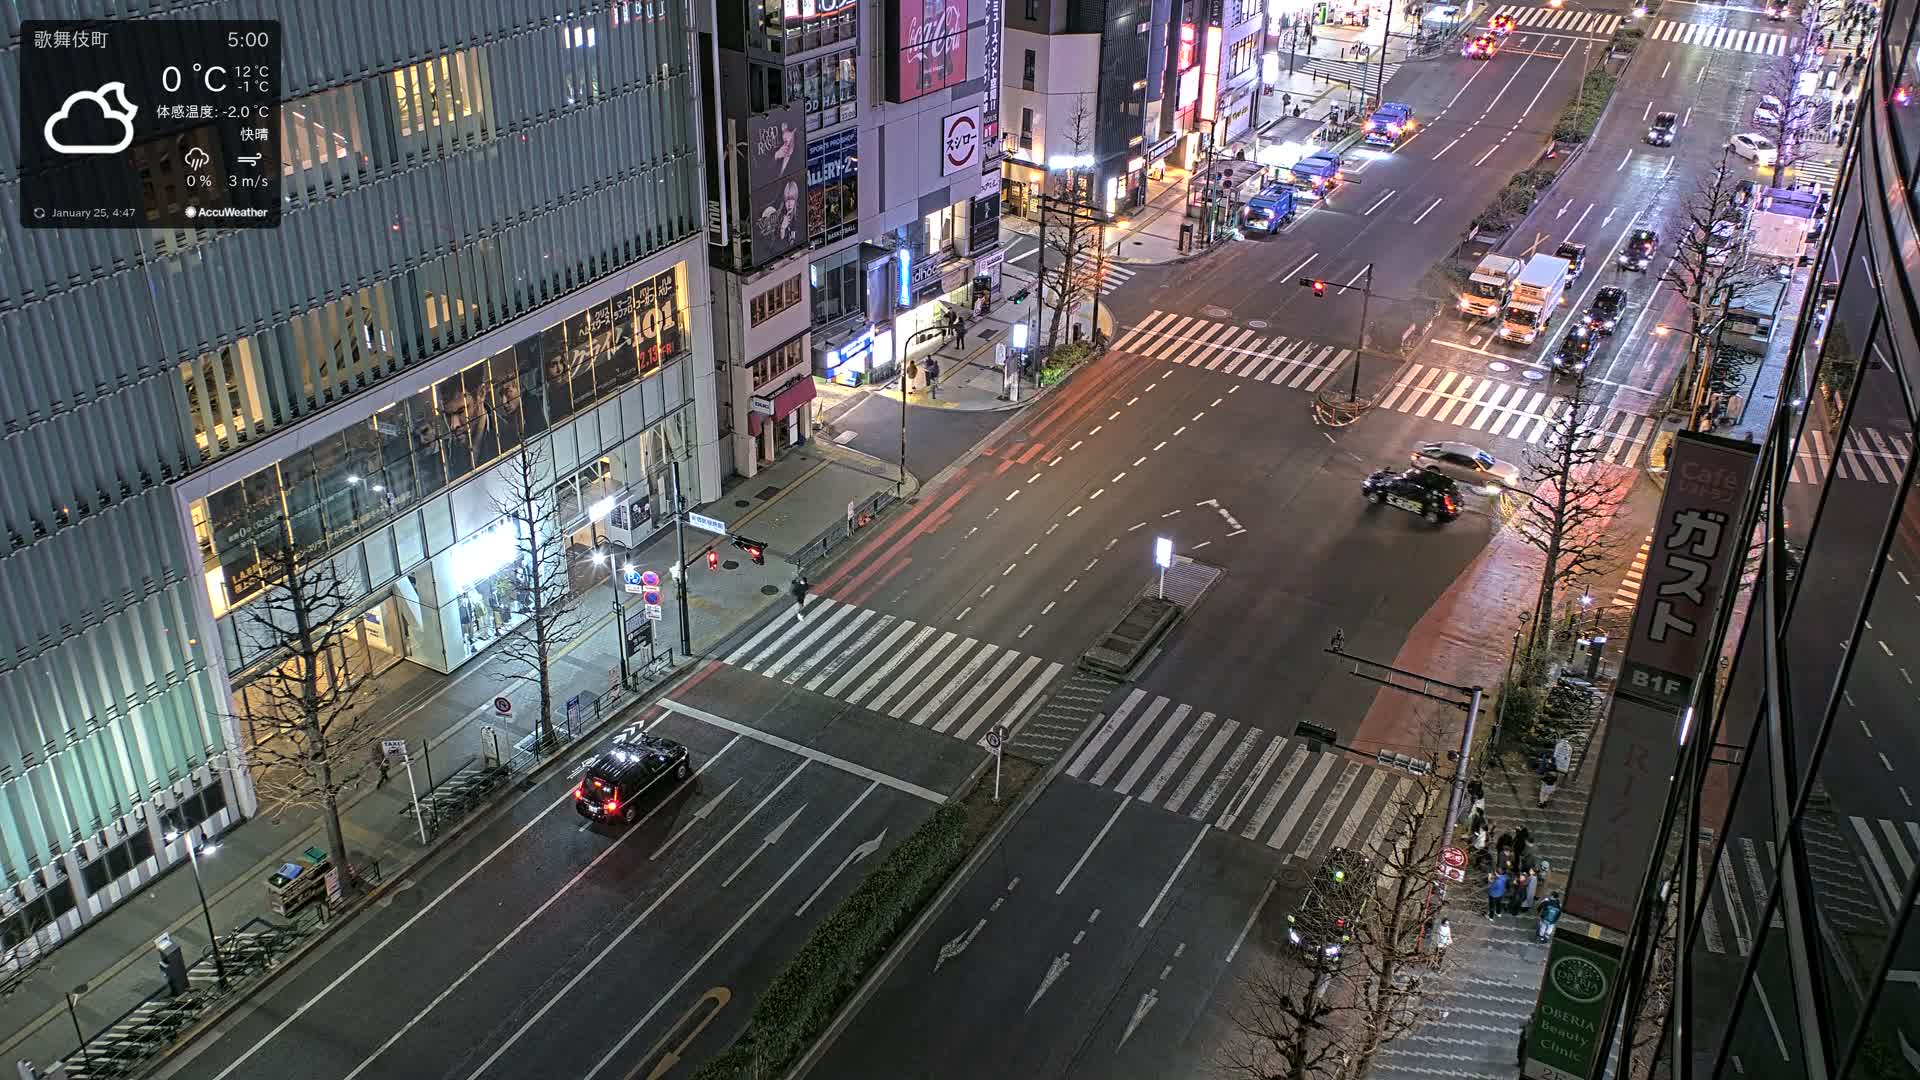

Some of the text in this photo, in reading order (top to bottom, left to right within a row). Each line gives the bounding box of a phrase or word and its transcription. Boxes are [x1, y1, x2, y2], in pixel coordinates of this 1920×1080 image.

[907, 6, 960, 63] Coca-Cola
[946, 133, 977, 152] スシロー
[708, 200, 721, 233] MUJI
[631, 300, 675, 348] 101
[1681, 462, 1737, 489] Café
[1651, 510, 1726, 642] ガスト
[1631, 670, 1681, 695] B1F
[1541, 1005, 1595, 1032] OBERIA
[1541, 1020, 1590, 1046] Beauty
[1540, 1039, 1583, 1062] Clinic
